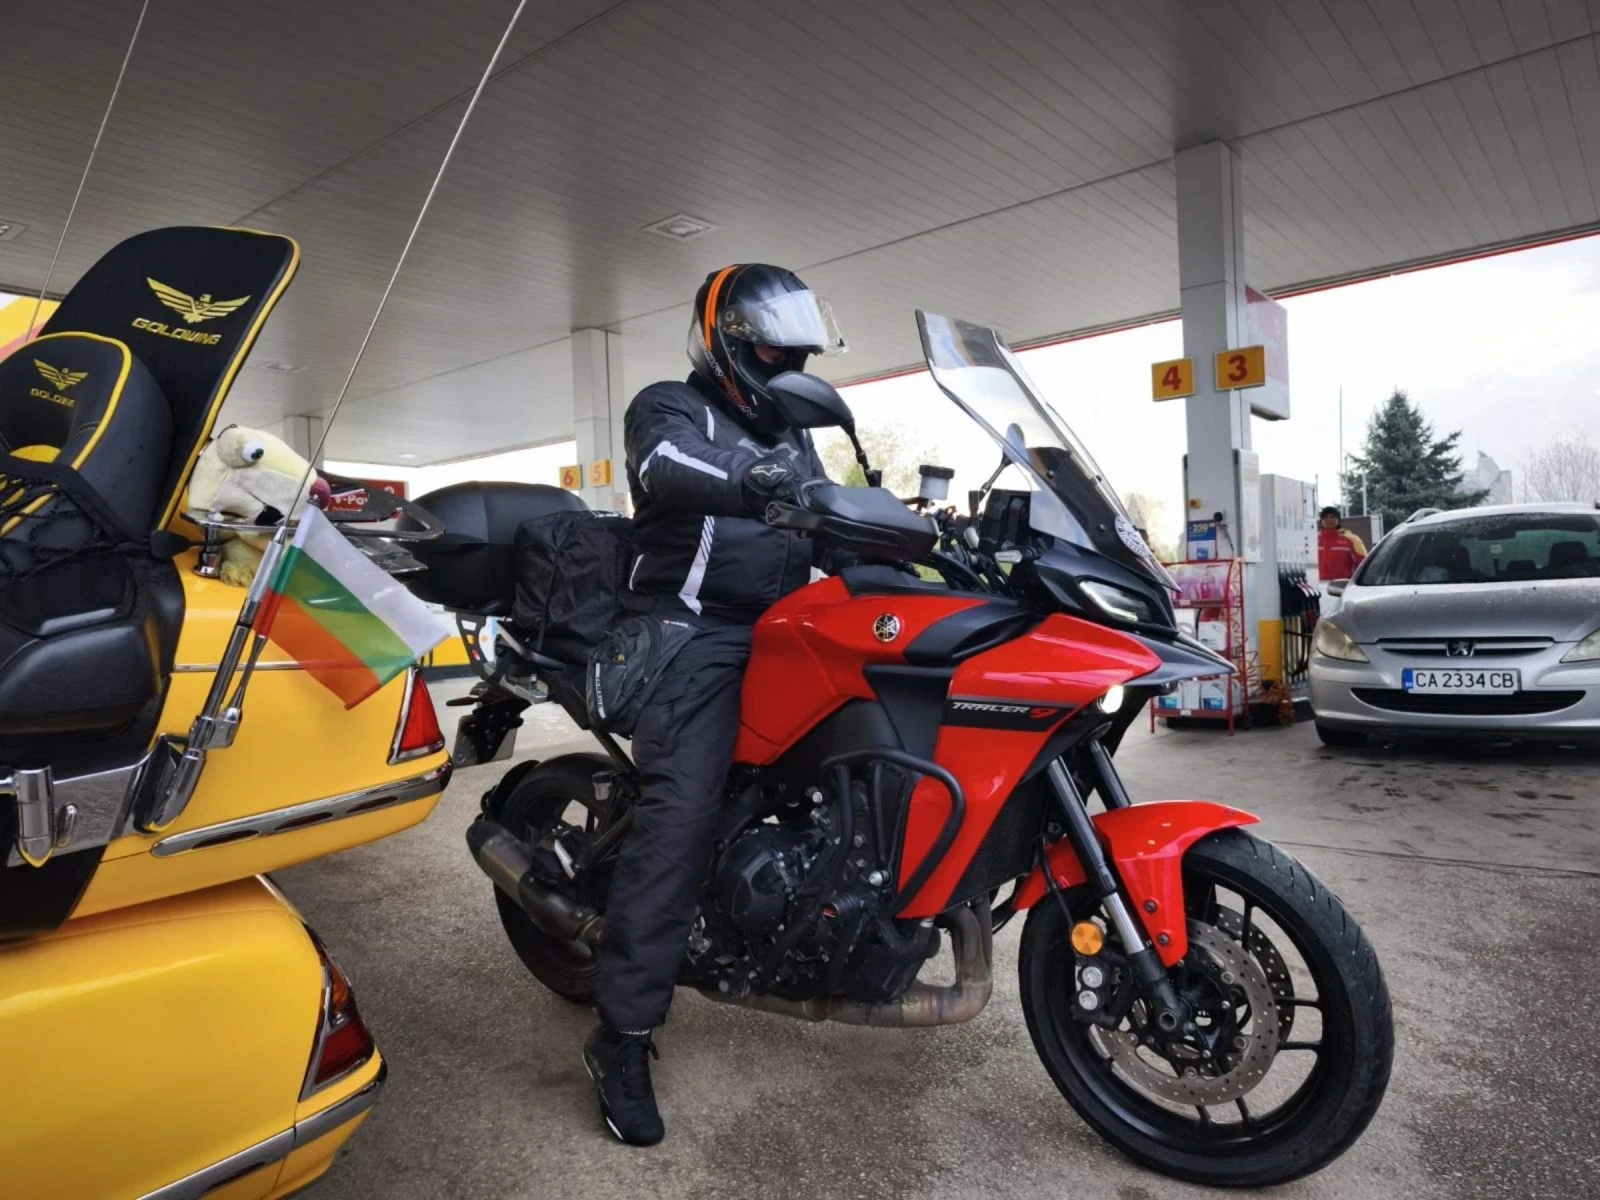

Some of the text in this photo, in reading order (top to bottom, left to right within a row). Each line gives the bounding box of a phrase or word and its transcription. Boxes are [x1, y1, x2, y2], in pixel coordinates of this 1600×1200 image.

[132, 317, 222, 345] GOLDWING
[1228, 354, 1248, 382] 3
[1162, 365, 1182, 391] 4
[563, 469, 574, 487] 6
[593, 464, 602, 482] 5
[1415, 672, 1514, 689] CA 2334 CB
[952, 701, 1058, 719] TRACER 9
